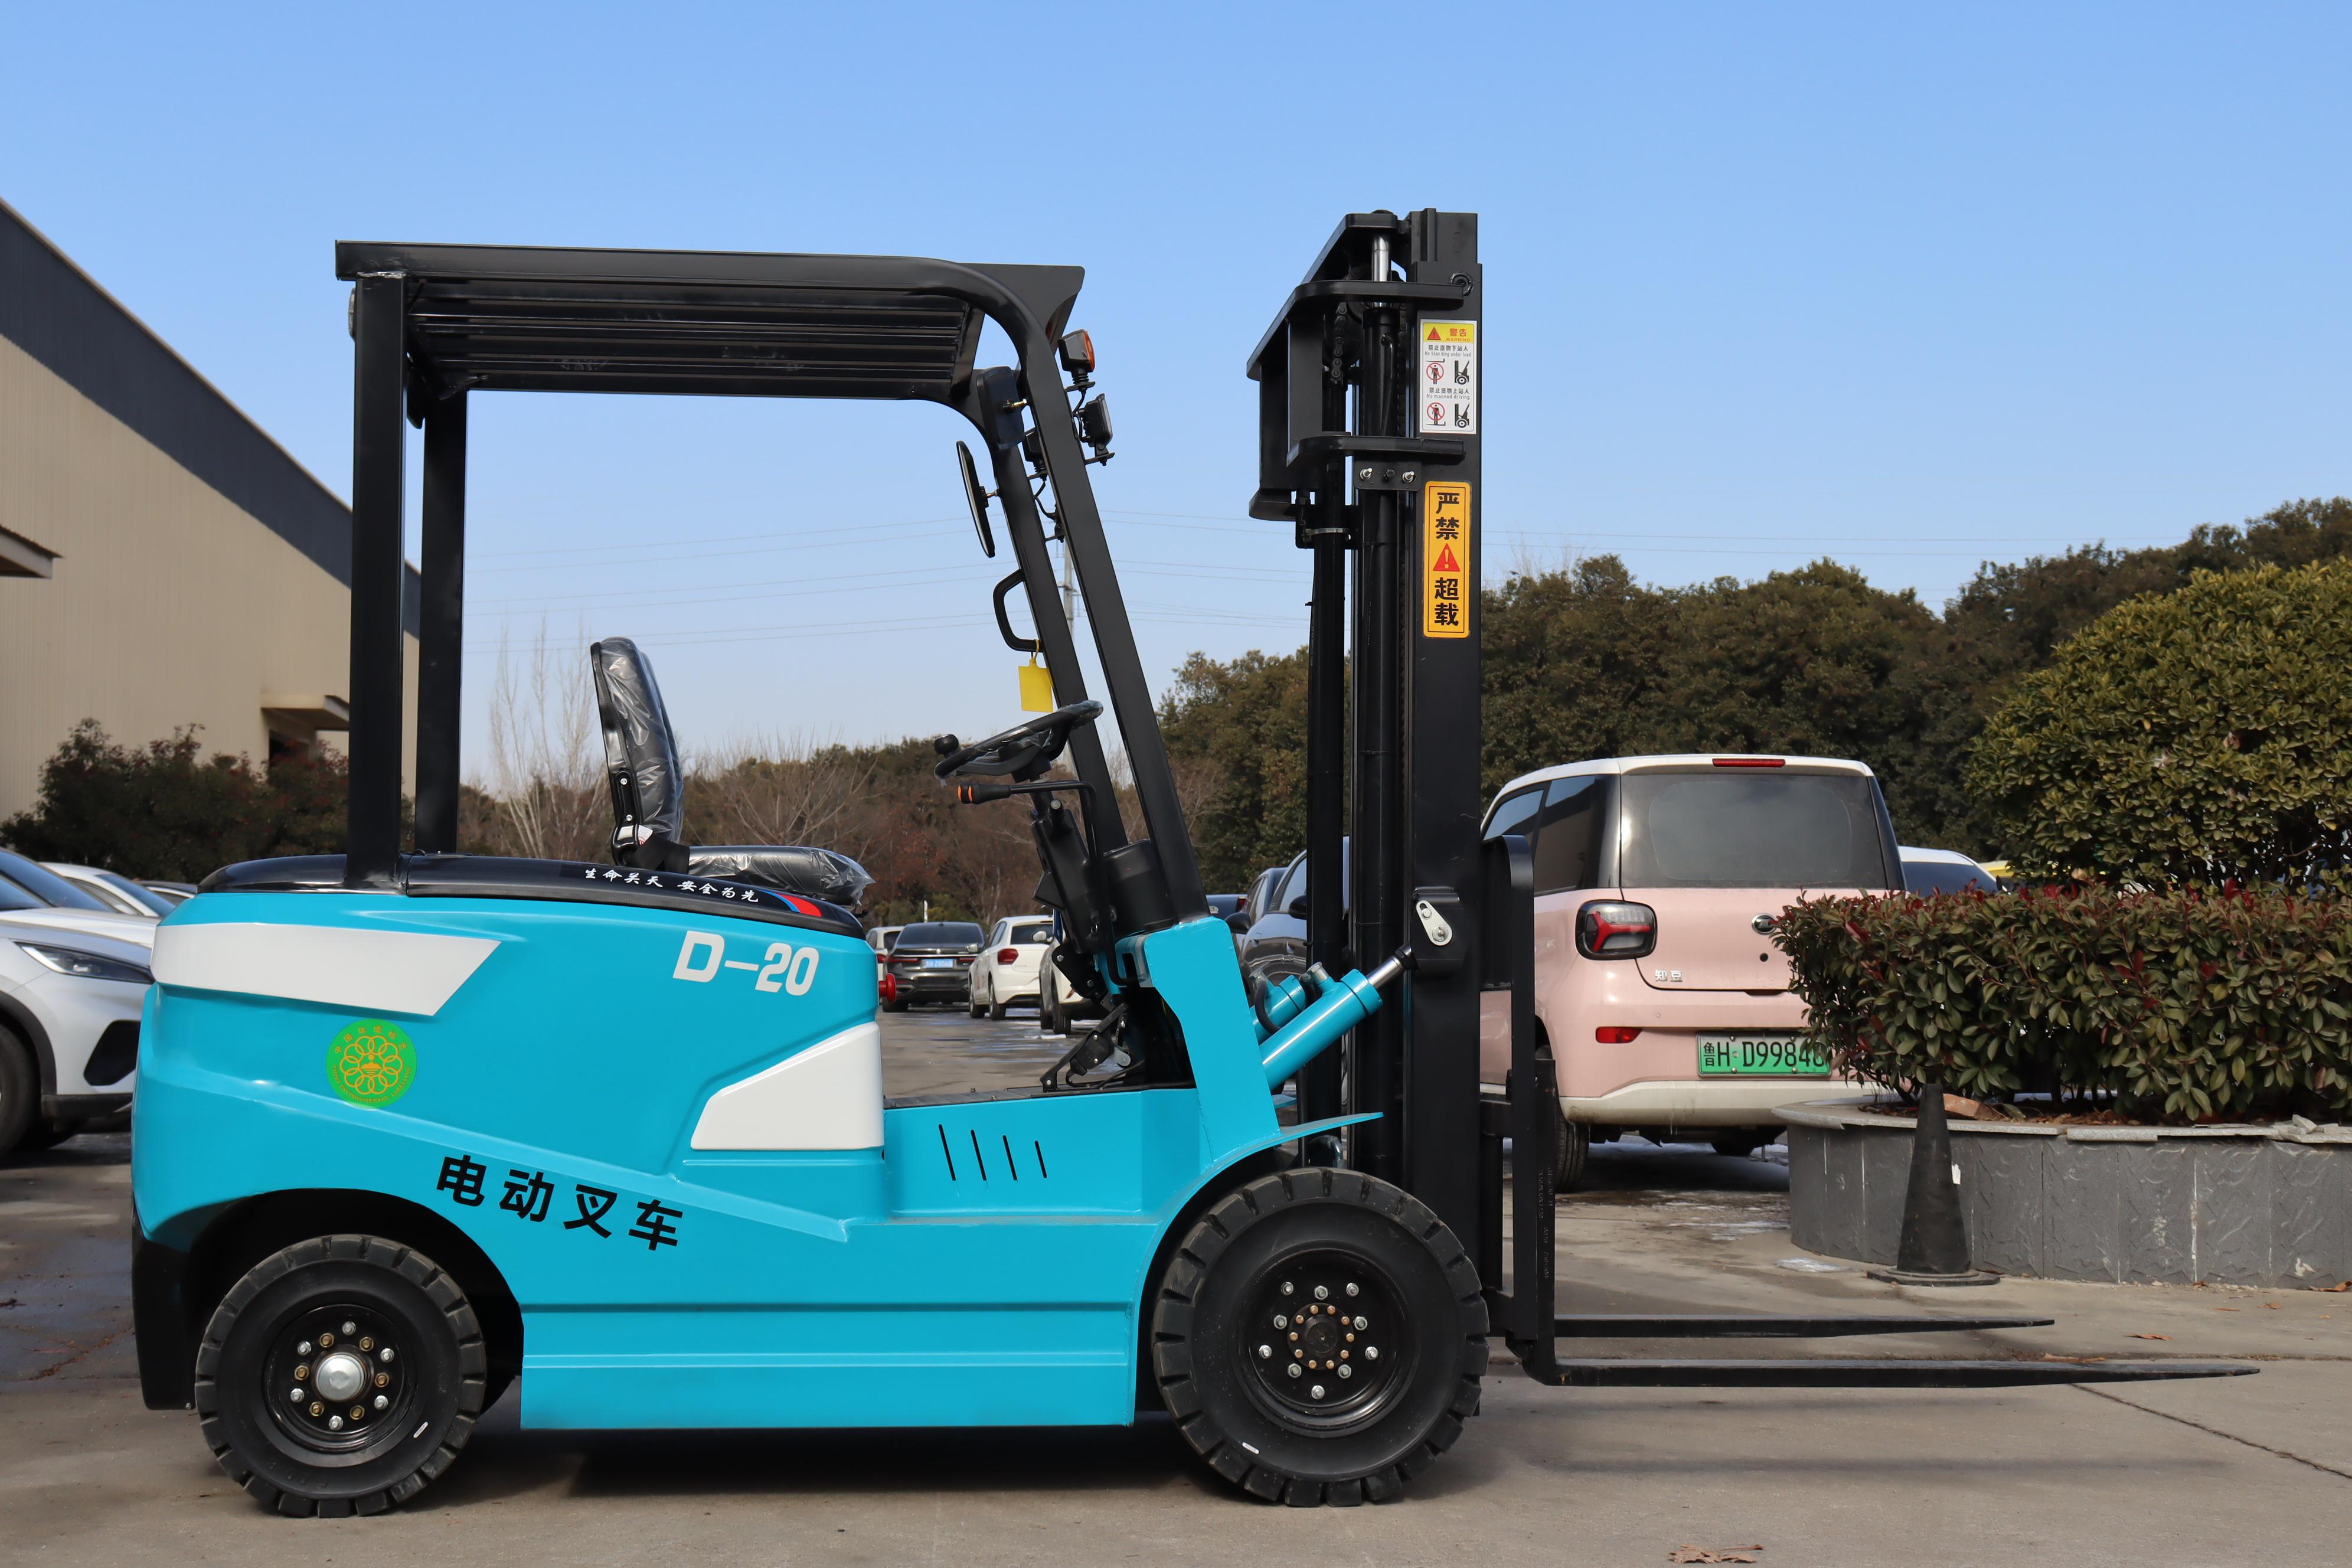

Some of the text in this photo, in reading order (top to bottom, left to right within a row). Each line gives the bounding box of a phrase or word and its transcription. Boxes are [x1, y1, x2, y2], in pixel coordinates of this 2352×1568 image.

[1434, 492, 1460, 626] 严禁 超载
[585, 868, 759, 903] 生命关天 安全为先
[1655, 969, 1682, 981] 知豆
[436, 1154, 683, 1251] 电动叉车
